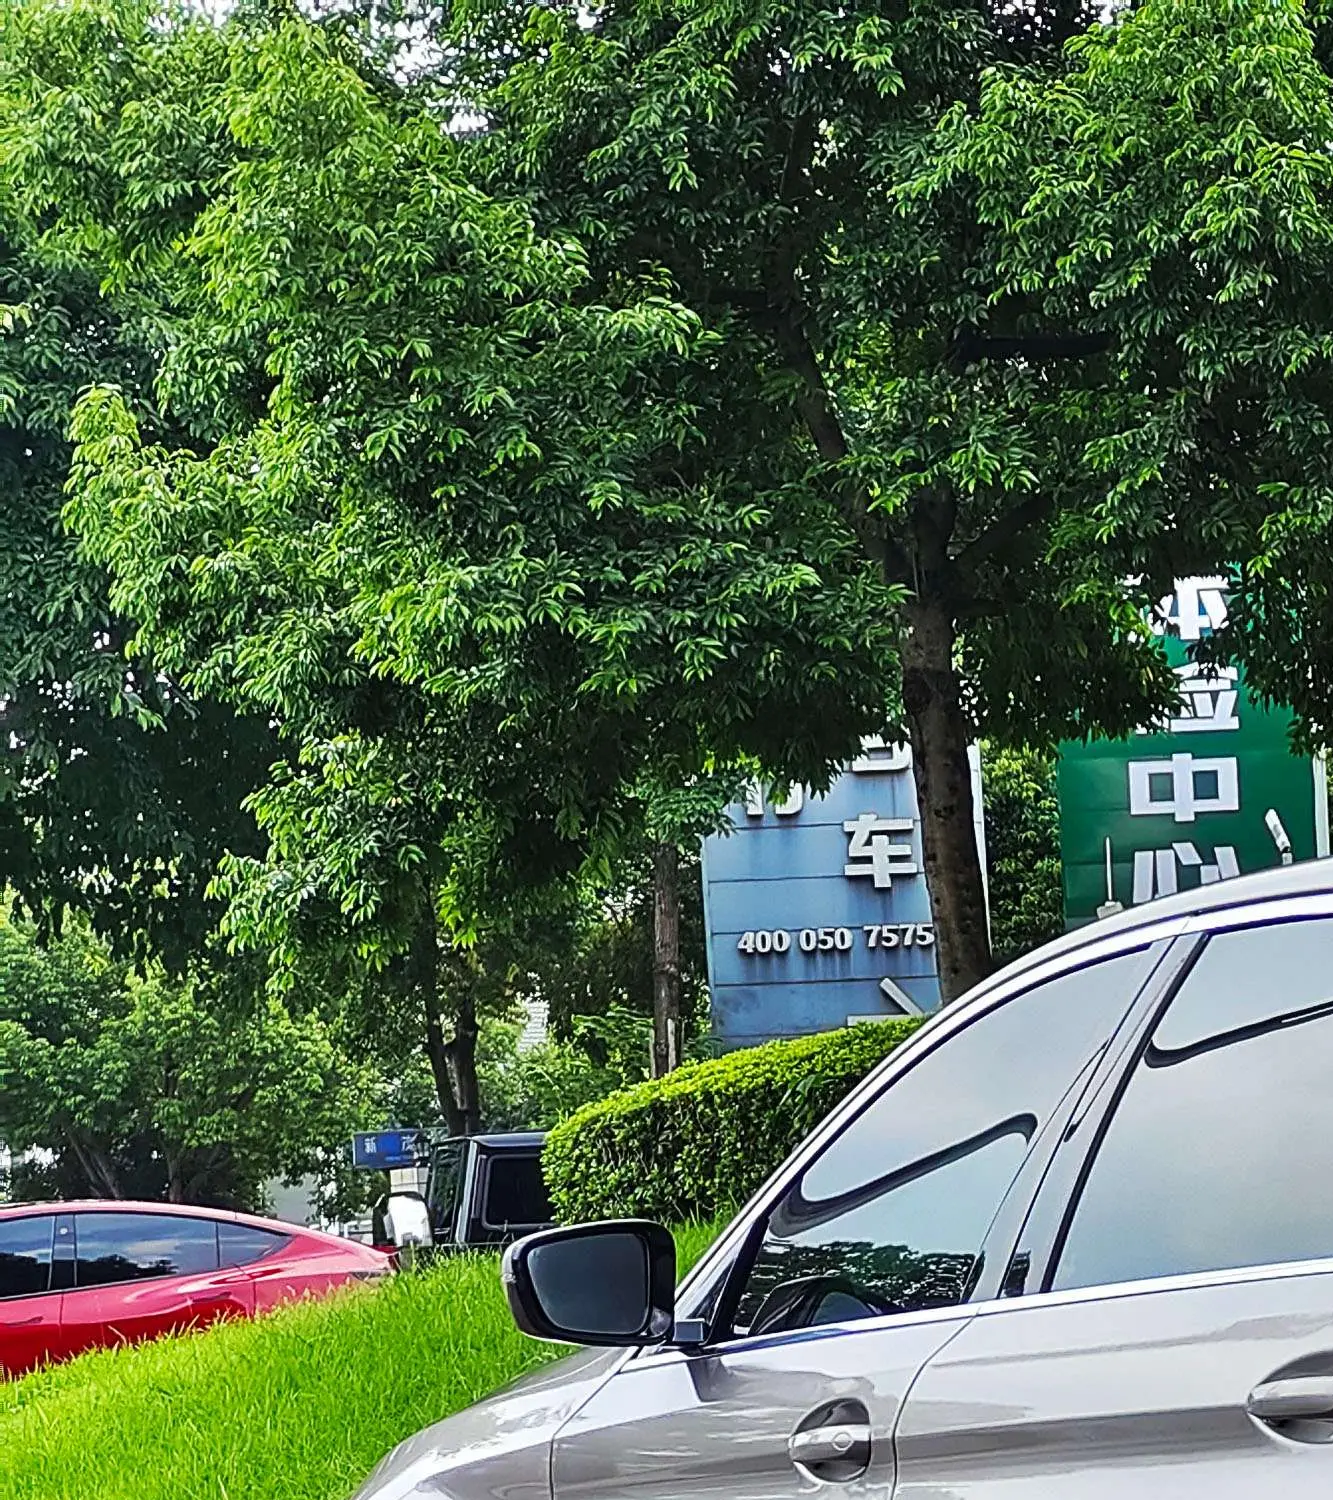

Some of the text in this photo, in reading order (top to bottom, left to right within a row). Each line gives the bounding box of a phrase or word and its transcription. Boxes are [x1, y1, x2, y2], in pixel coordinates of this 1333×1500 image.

[737, 923, 935, 953] 400 050 7575
